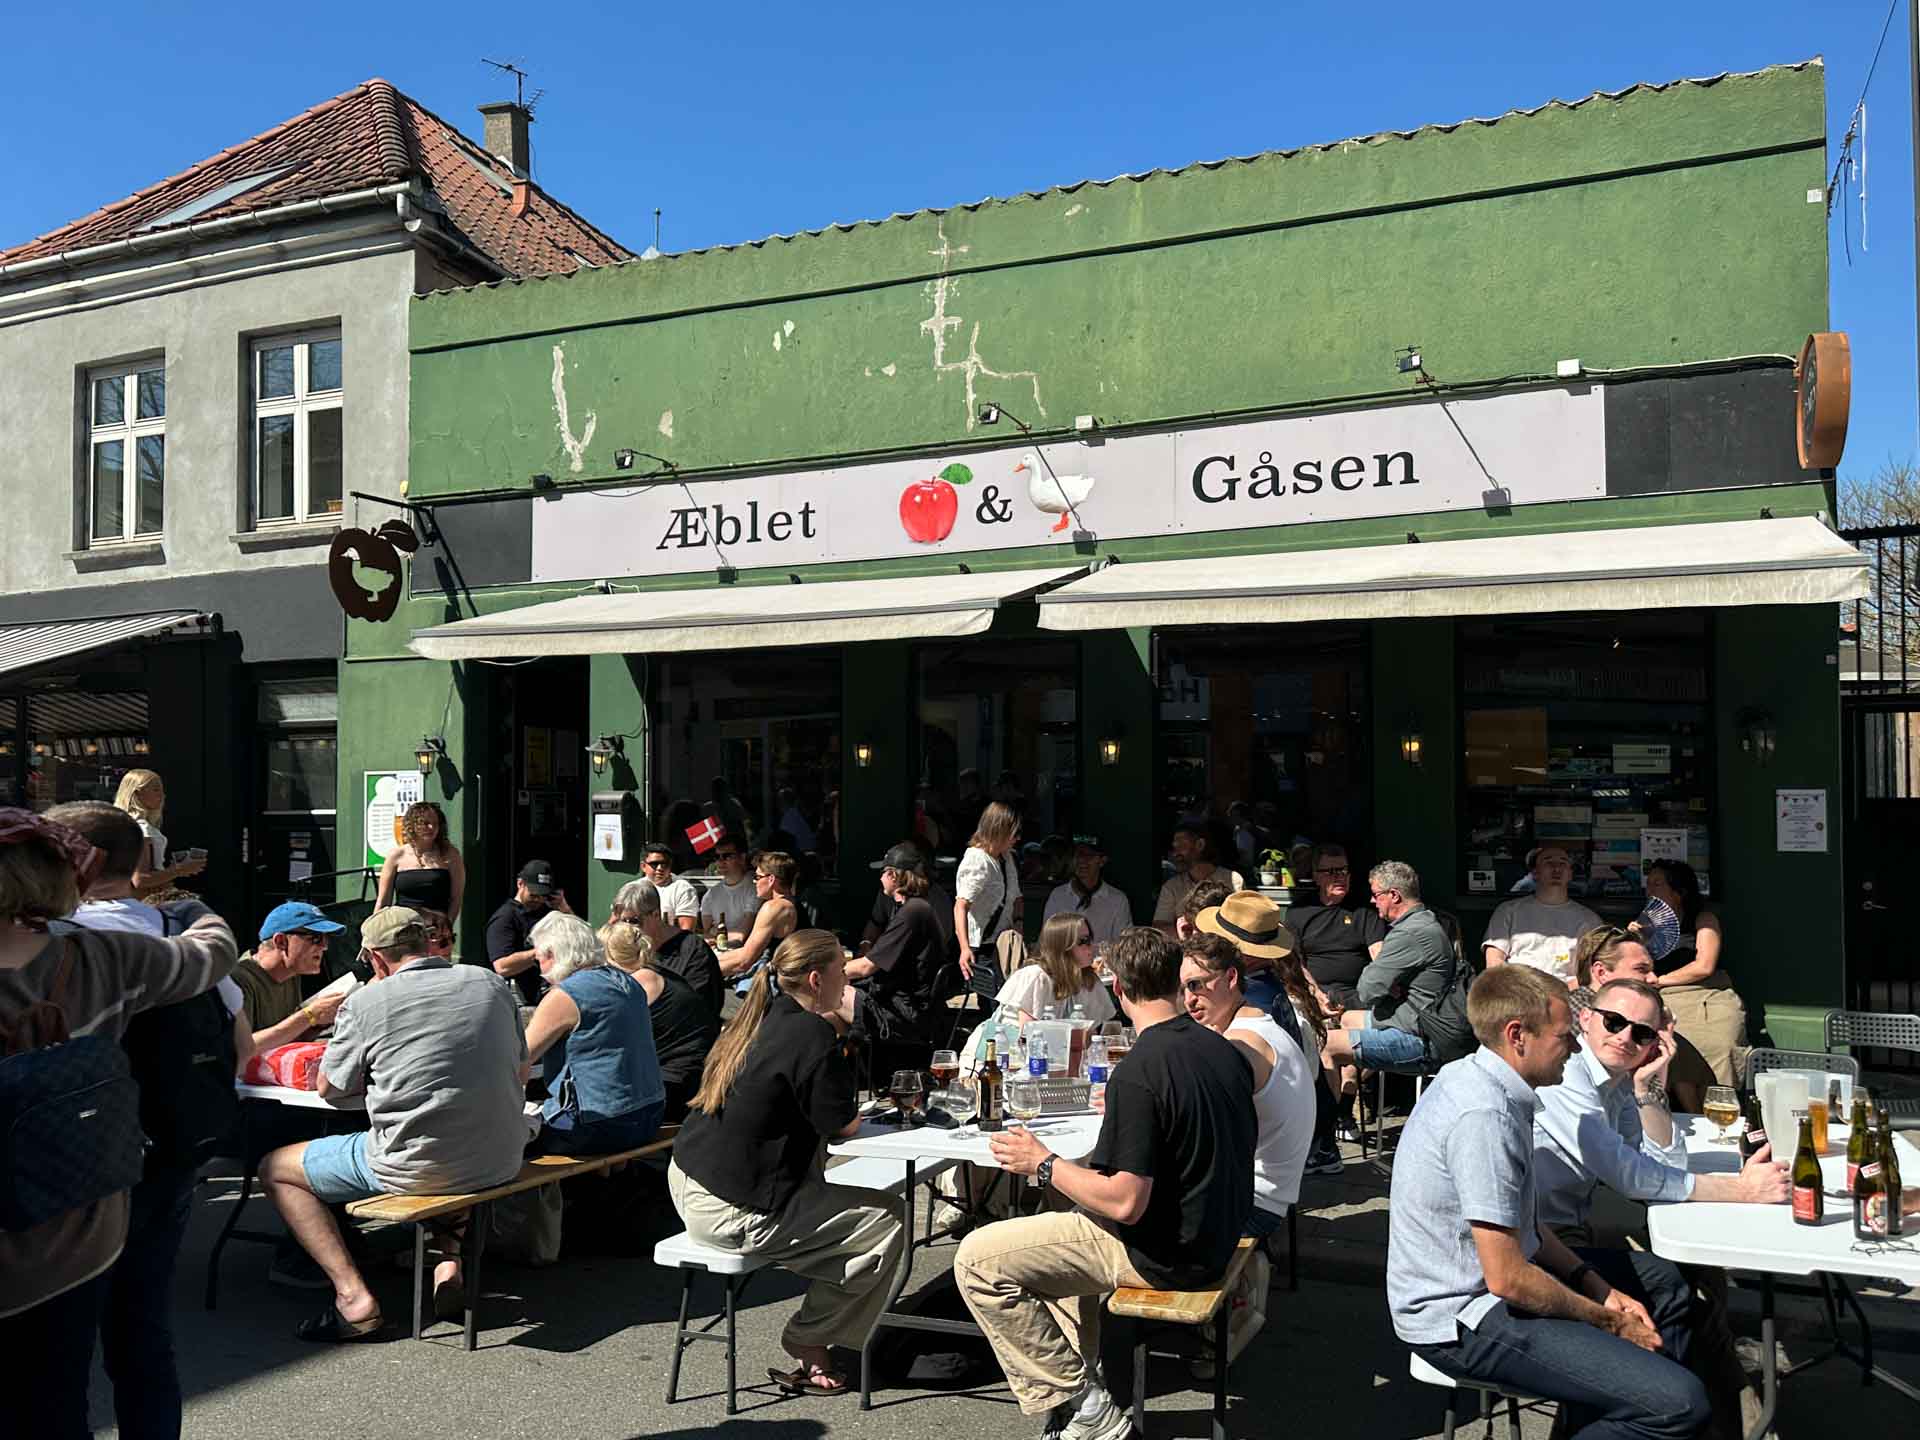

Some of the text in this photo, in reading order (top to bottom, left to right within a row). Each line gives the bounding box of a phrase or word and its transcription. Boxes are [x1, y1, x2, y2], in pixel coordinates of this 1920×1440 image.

[656, 451, 1420, 550] Æblet & Gåsen
